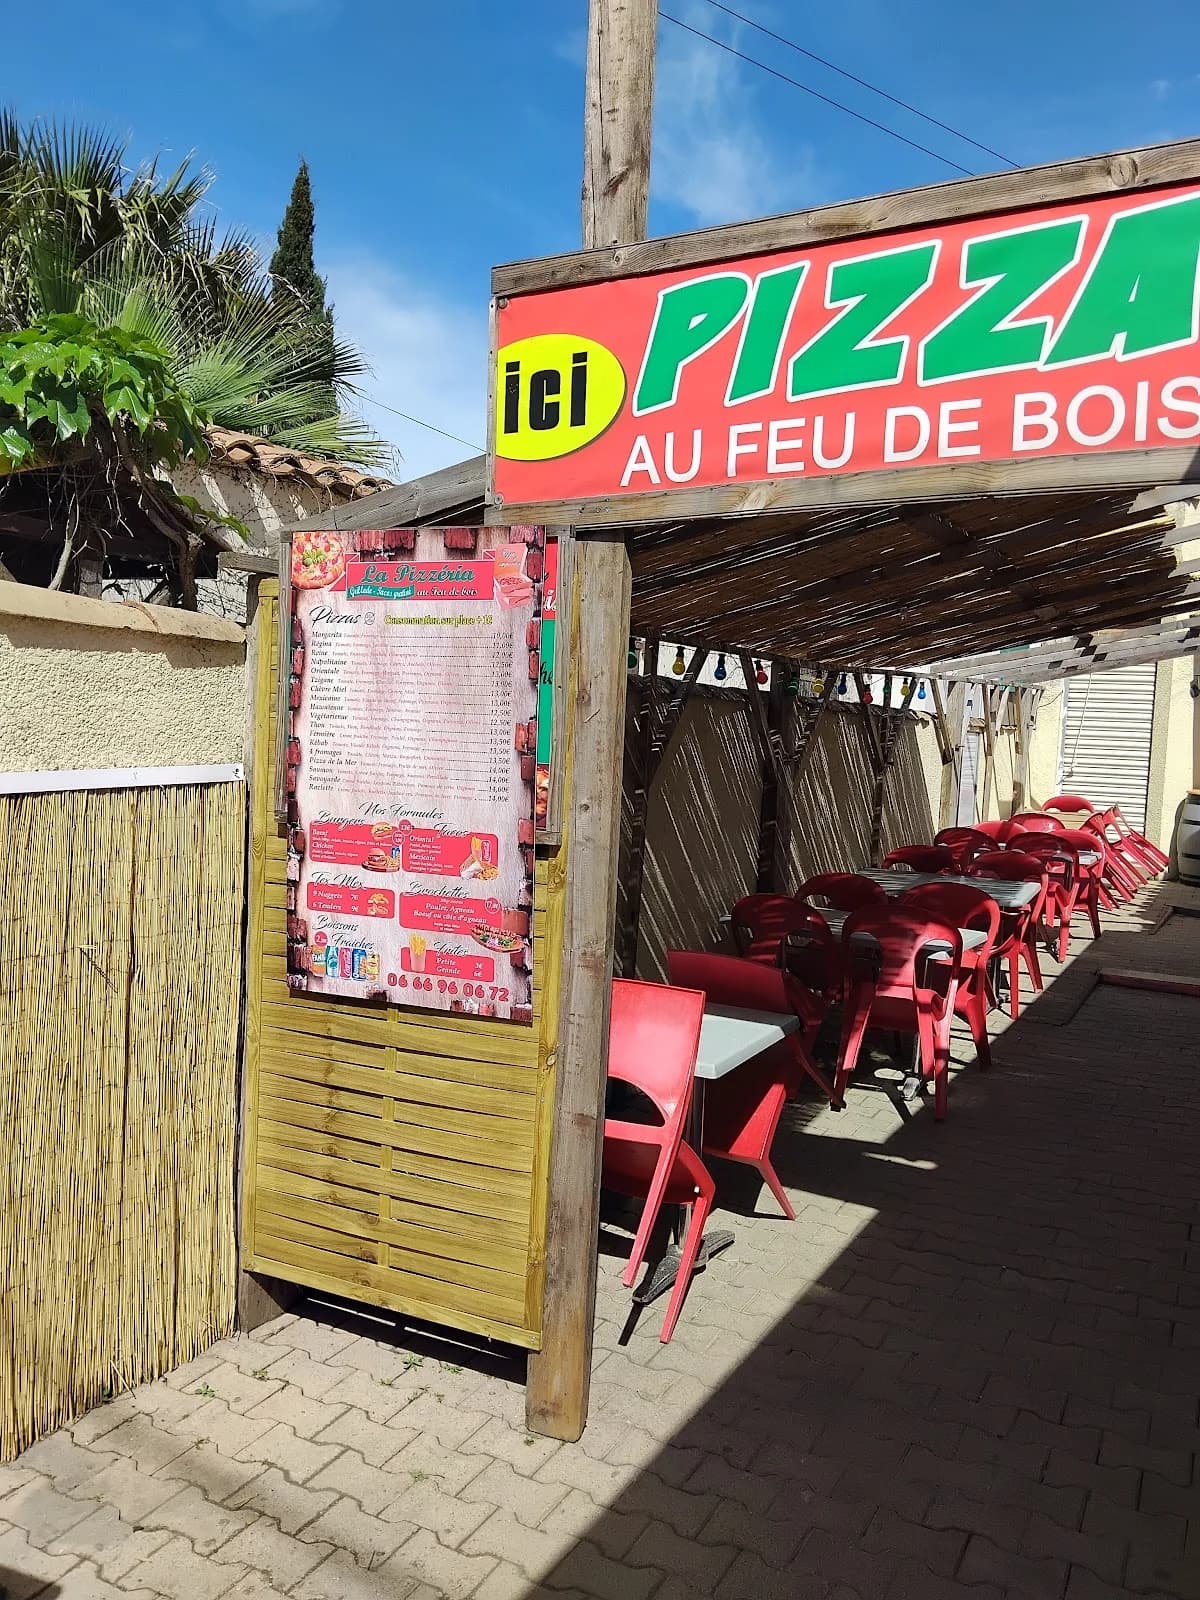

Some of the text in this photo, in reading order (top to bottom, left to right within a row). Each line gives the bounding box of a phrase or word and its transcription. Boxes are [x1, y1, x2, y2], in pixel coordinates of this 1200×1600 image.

[633, 191, 1200, 415] PIZZA
[503, 351, 588, 435] ici
[619, 374, 1200, 487] AU FEU DE BOIS
[361, 563, 475, 584] La Pizzéria
[309, 605, 361, 628] Pizzas
[312, 631, 342, 639] Margarita
[311, 658, 347, 666] Napolitaine
[311, 667, 340, 675] Orientale
[309, 774, 341, 783] Savoyarde
[359, 802, 444, 819] Nos Formules
[313, 810, 366, 830] Burgers
[434, 822, 468, 838] Tacos
[409, 835, 434, 843] Oriental
[311, 871, 367, 889] Tex Mex
[318, 890, 343, 899] Nuggets
[403, 881, 470, 899] Brochettes
[318, 902, 342, 910] Tenders
[449, 905, 475, 914] Agneau
[312, 914, 360, 932] Boissons
[433, 941, 469, 956] Frites
[436, 957, 457, 966] Petite
[387, 972, 510, 1003] 06 66 96 06 72
